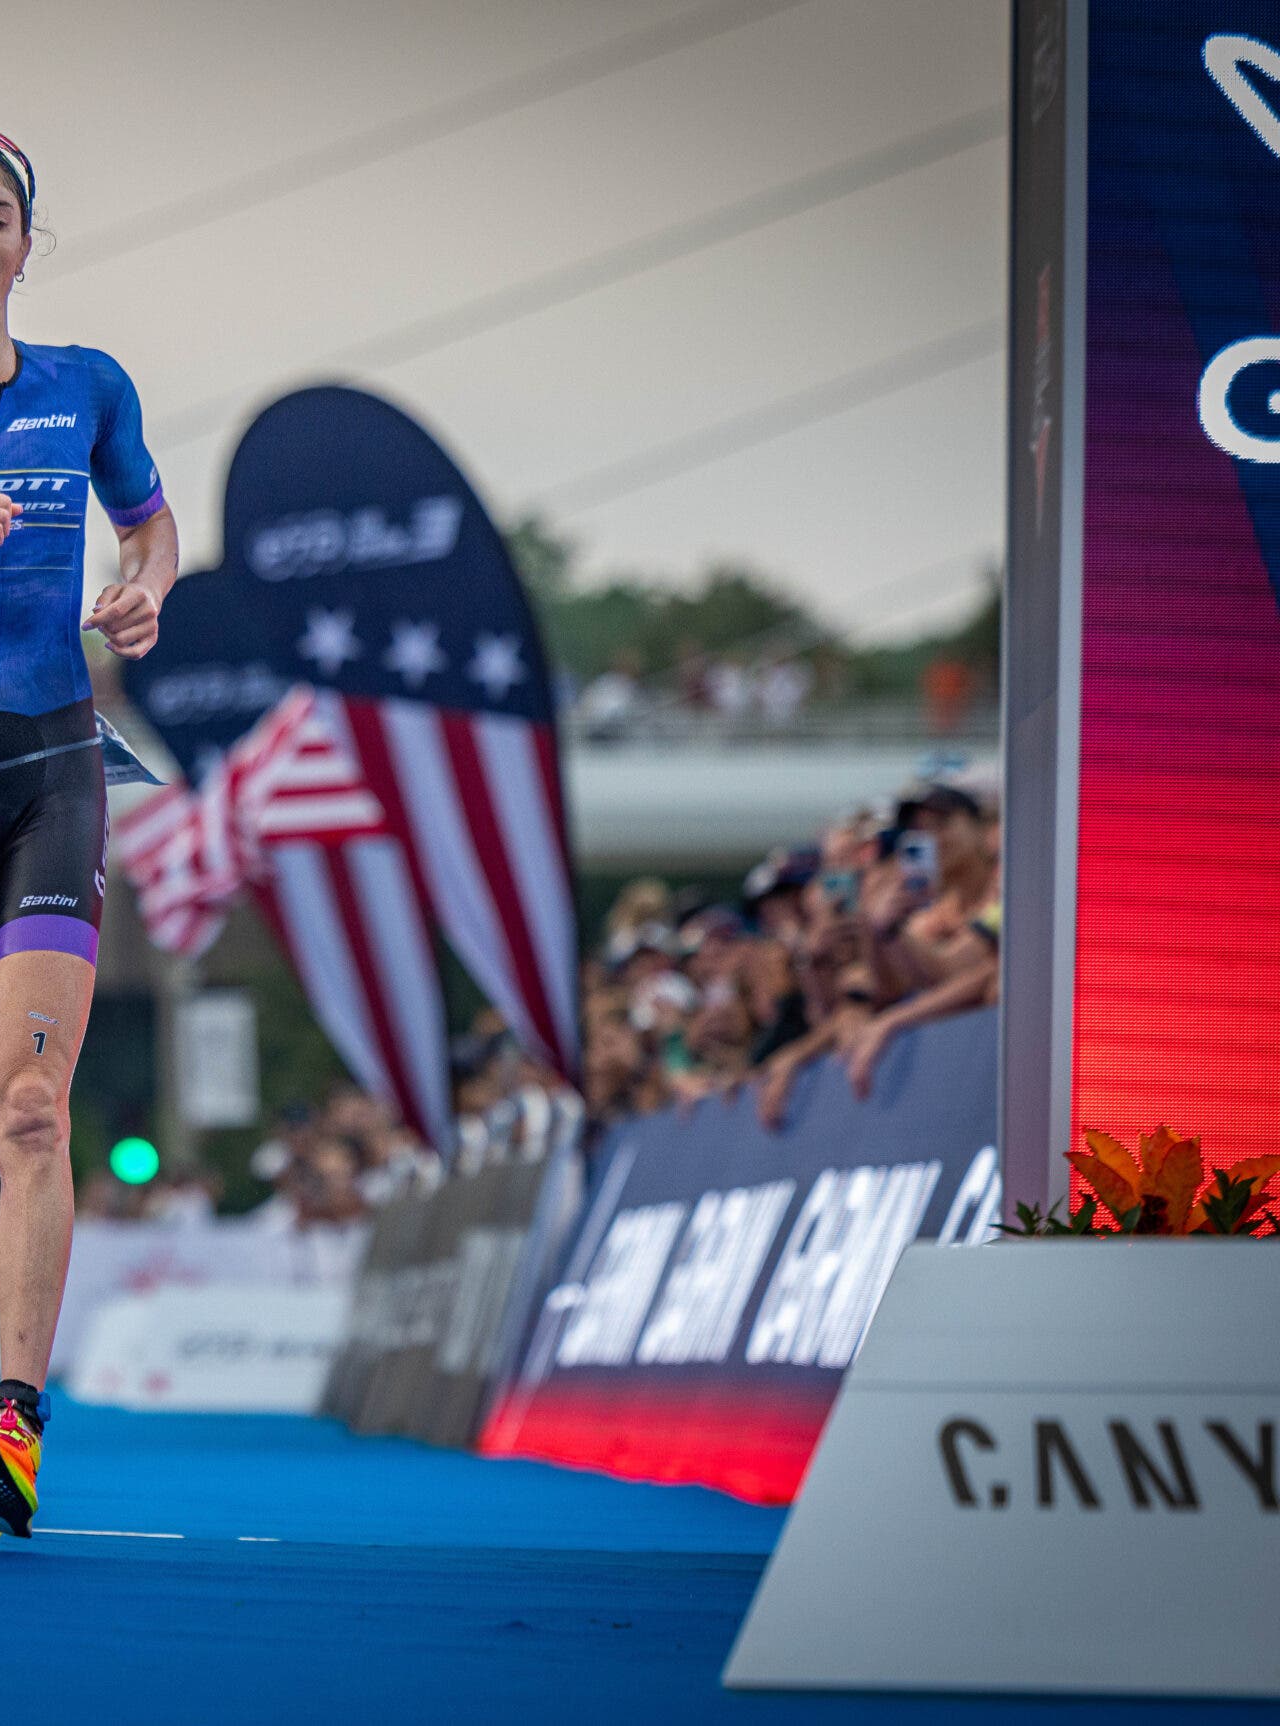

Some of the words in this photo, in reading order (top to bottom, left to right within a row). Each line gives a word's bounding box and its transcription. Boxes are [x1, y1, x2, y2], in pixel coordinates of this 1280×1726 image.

[7, 414, 77, 432] Santini
[19, 502, 66, 511] IPP
[19, 894, 79, 909] Santini
[31, 1030, 48, 1056] 1
